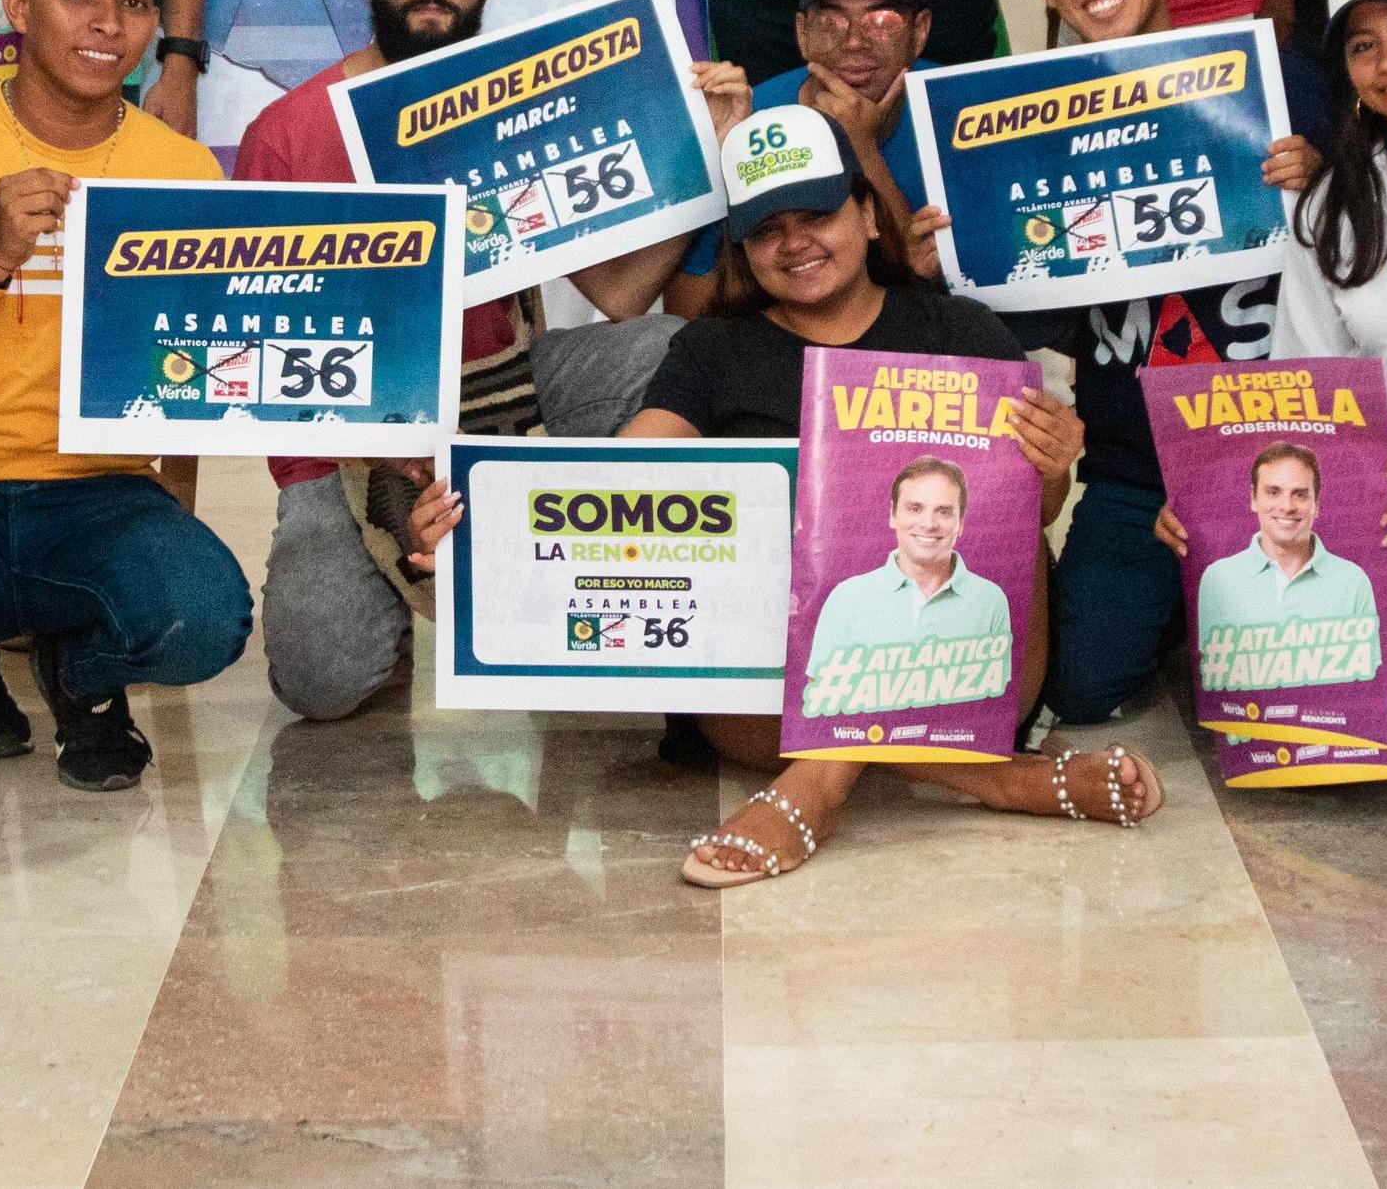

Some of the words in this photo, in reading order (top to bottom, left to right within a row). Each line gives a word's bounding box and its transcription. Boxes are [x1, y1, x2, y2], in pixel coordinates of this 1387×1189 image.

[405, 90, 479, 139] JUAN
[487, 69, 524, 107] DE
[531, 25, 639, 89] ACOSTA
[957, 99, 1060, 142] CAMPO
[1067, 89, 1105, 120] DE
[1112, 81, 1148, 110] LA
[1157, 62, 1236, 101] CRUZ
[496, 95, 576, 141] MARCA:
[748, 124, 787, 156] 56
[1070, 122, 1159, 156] MARCA:
[566, 153, 636, 214] 56
[1010, 154, 1213, 202] ASAMBLEA
[1134, 186, 1206, 244] 56
[114, 230, 423, 272] SABANALARGA
[467, 232, 508, 254] Verde
[1023, 246, 1065, 263] Verde
[226, 275, 324, 295] MARCA:
[154, 313, 373, 335] ASAMBLEA
[210, 340, 247, 348] AVANZA
[281, 347, 357, 398] 56
[874, 367, 978, 394] ALFREDO
[1212, 370, 1312, 393] ALFREDO
[157, 384, 200, 401] Verde
[832, 386, 1018, 439] VARELA
[1174, 388, 1366, 430] VARELA
[870, 430, 991, 450] GOBERNADOR
[1220, 420, 1336, 436] GOBERNADOR
[533, 493, 733, 534] SOMOS
[535, 543, 566, 561] LA
[578, 578, 600, 588] POR
[603, 578, 625, 588] ESO
[627, 579, 642, 589] YO
[645, 579, 689, 589] MARCO:
[568, 598, 697, 610] ASAMBLEA
[571, 640, 597, 650] Verde
[643, 617, 689, 648] 56
[1227, 641, 1371, 687] AVANZA
[852, 664, 1003, 711] AVANZA
[833, 727, 866, 740] Verde
